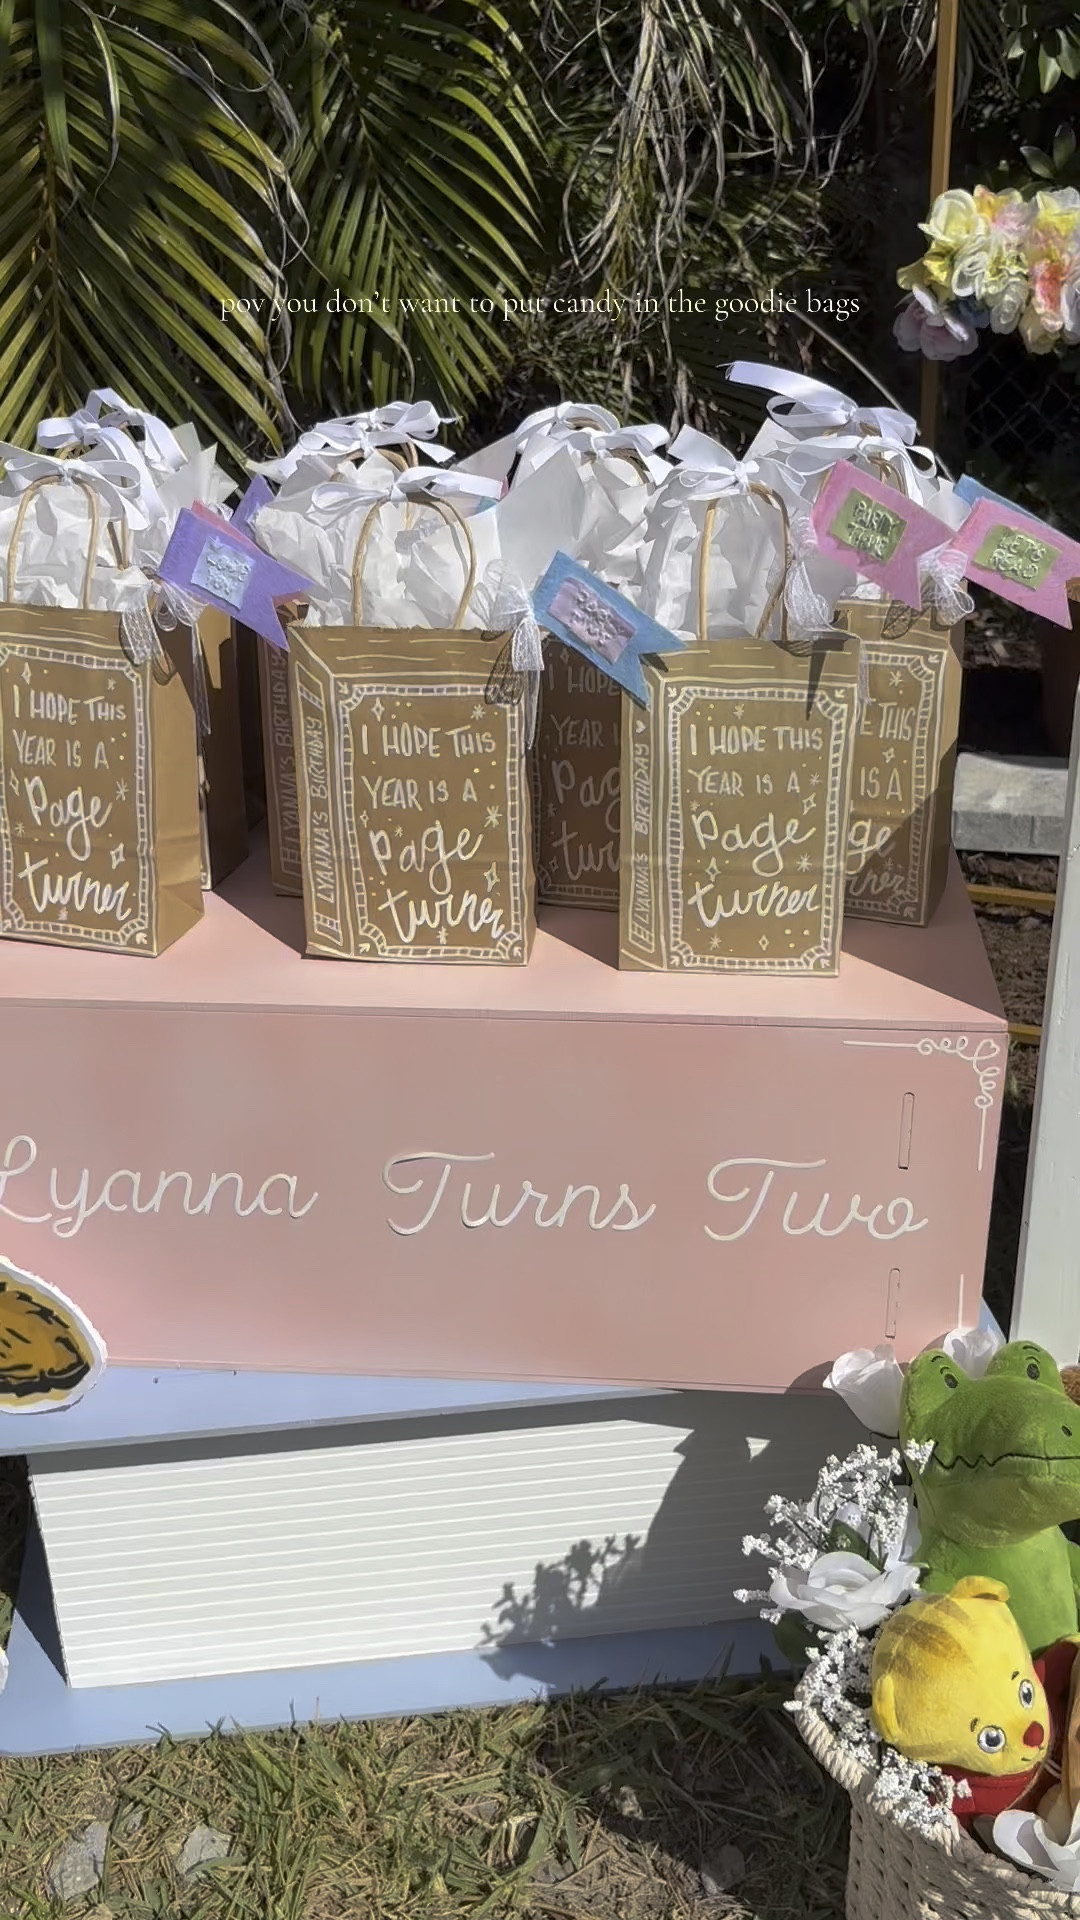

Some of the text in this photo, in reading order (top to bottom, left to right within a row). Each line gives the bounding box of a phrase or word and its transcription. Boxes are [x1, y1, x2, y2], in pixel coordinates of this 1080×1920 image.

[13, 684, 127, 726] I HOPE THIS
[878, 702, 916, 741] THIS
[11, 729, 110, 770] YEAR IS A
[361, 722, 496, 758] I HOPE THIS
[550, 713, 604, 748] YEAR
[690, 725, 823, 755] I HOPE THIS
[306, 715, 328, 800] BIRTHDAY
[361, 775, 478, 812] YEAR IS A
[634, 743, 650, 835] BIRTHDAY
[688, 766, 800, 796] YEAR IS A
[860, 766, 902, 801] IS A
[382, 1151, 656, 1237] Turns
[705, 1157, 929, 1242] Two
